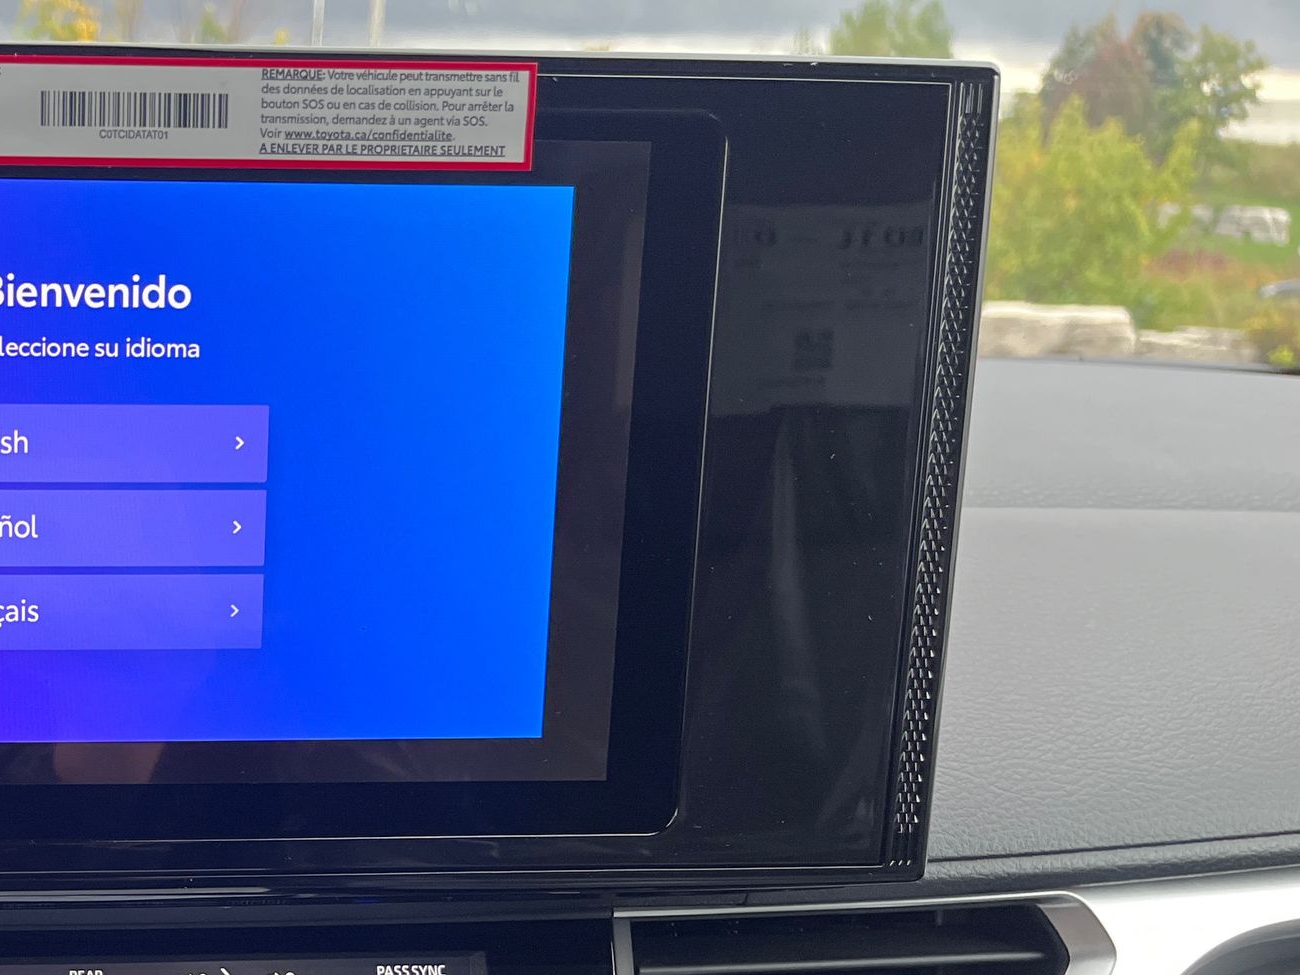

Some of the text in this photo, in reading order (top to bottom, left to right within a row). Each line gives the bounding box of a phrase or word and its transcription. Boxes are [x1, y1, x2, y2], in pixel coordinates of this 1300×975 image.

[261, 68, 521, 84] REMARQUE: Votre véhicule peut transmettre sans fil
[261, 83, 504, 99] des données de localisation en appuyant sur le
[260, 97, 515, 112] bouton SOS ou en cas de collision. Pour arrêter la
[260, 113, 489, 129] transmission, demandez à un agent via SOS.
[259, 128, 456, 145] Voir www.toyota.ca/confidentialite.
[259, 142, 506, 157] A ENLEVER PAR LE PROPRIETAIRE SEULEMENT
[95, 342, 118, 358] su
[125, 337, 200, 358] idioma
